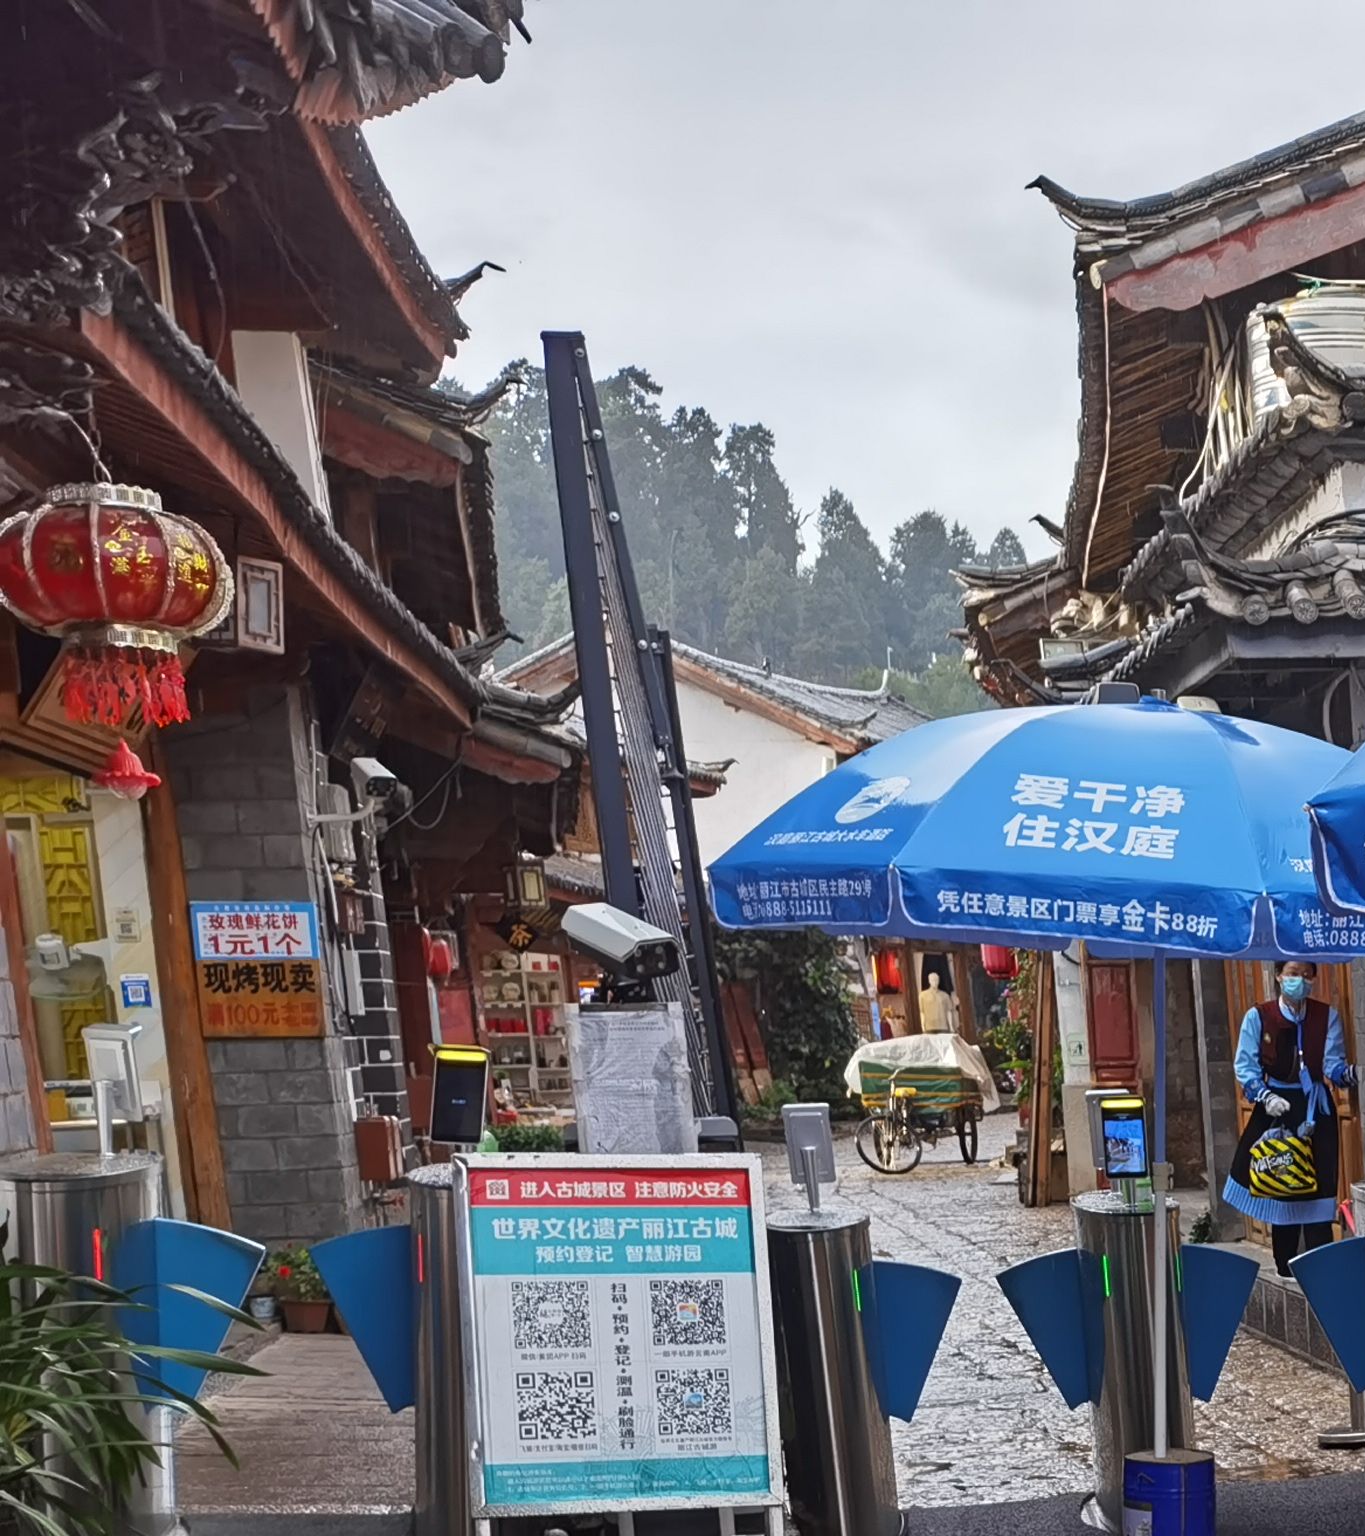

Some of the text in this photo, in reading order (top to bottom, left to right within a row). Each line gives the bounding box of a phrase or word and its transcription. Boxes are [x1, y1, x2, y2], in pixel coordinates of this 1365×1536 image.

[1011, 773, 1186, 818] 爱干净
[1002, 812, 1180, 860] 住汉庭
[936, 889, 1219, 938] 凭任意景区门票享金卡88折
[207, 932, 302, 956] 1元1个
[203, 961, 316, 995] 现烤现卖
[520, 1180, 739, 1199] 进入古城景区 注意防火安全
[491, 1216, 739, 1241] 世界文化遗产丽江古城
[535, 1243, 702, 1264] 预约登记 智慧游园
